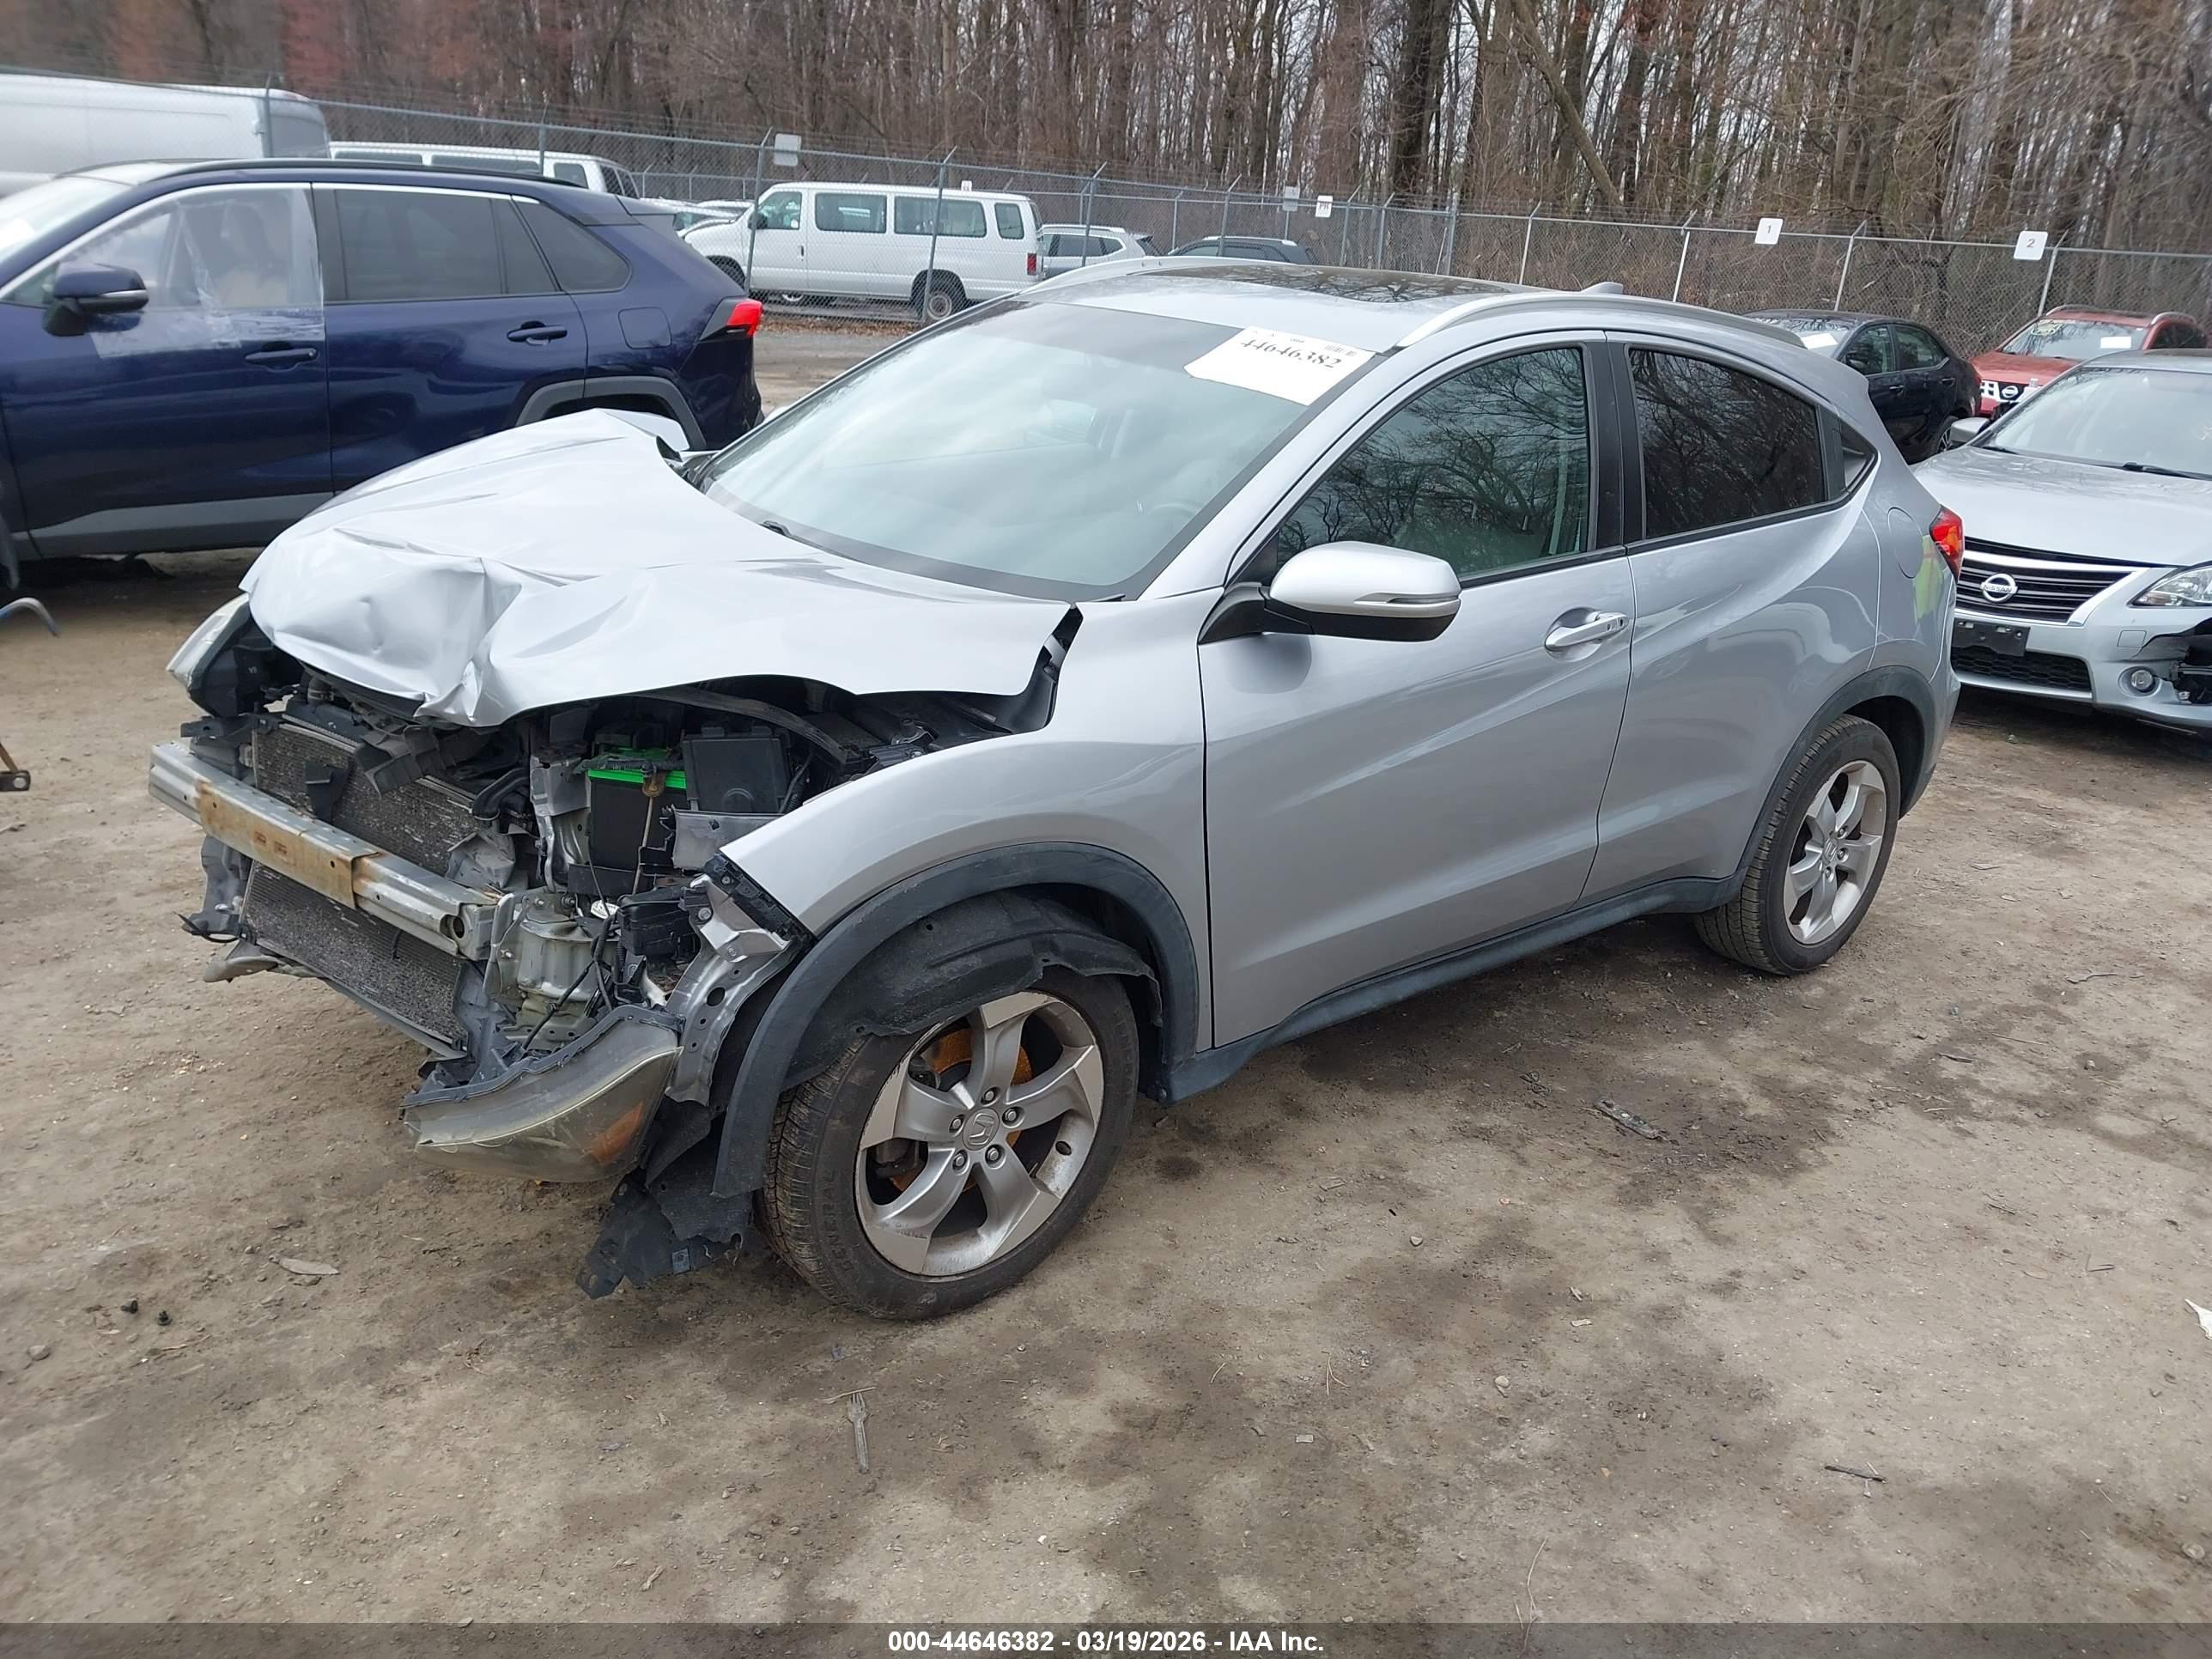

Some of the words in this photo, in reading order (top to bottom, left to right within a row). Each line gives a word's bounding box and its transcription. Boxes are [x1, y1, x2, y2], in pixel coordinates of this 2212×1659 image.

[2027, 239, 2035, 247] 2
[1241, 339, 1342, 368] 44646382
[1984, 584, 2013, 592] NISSAN
